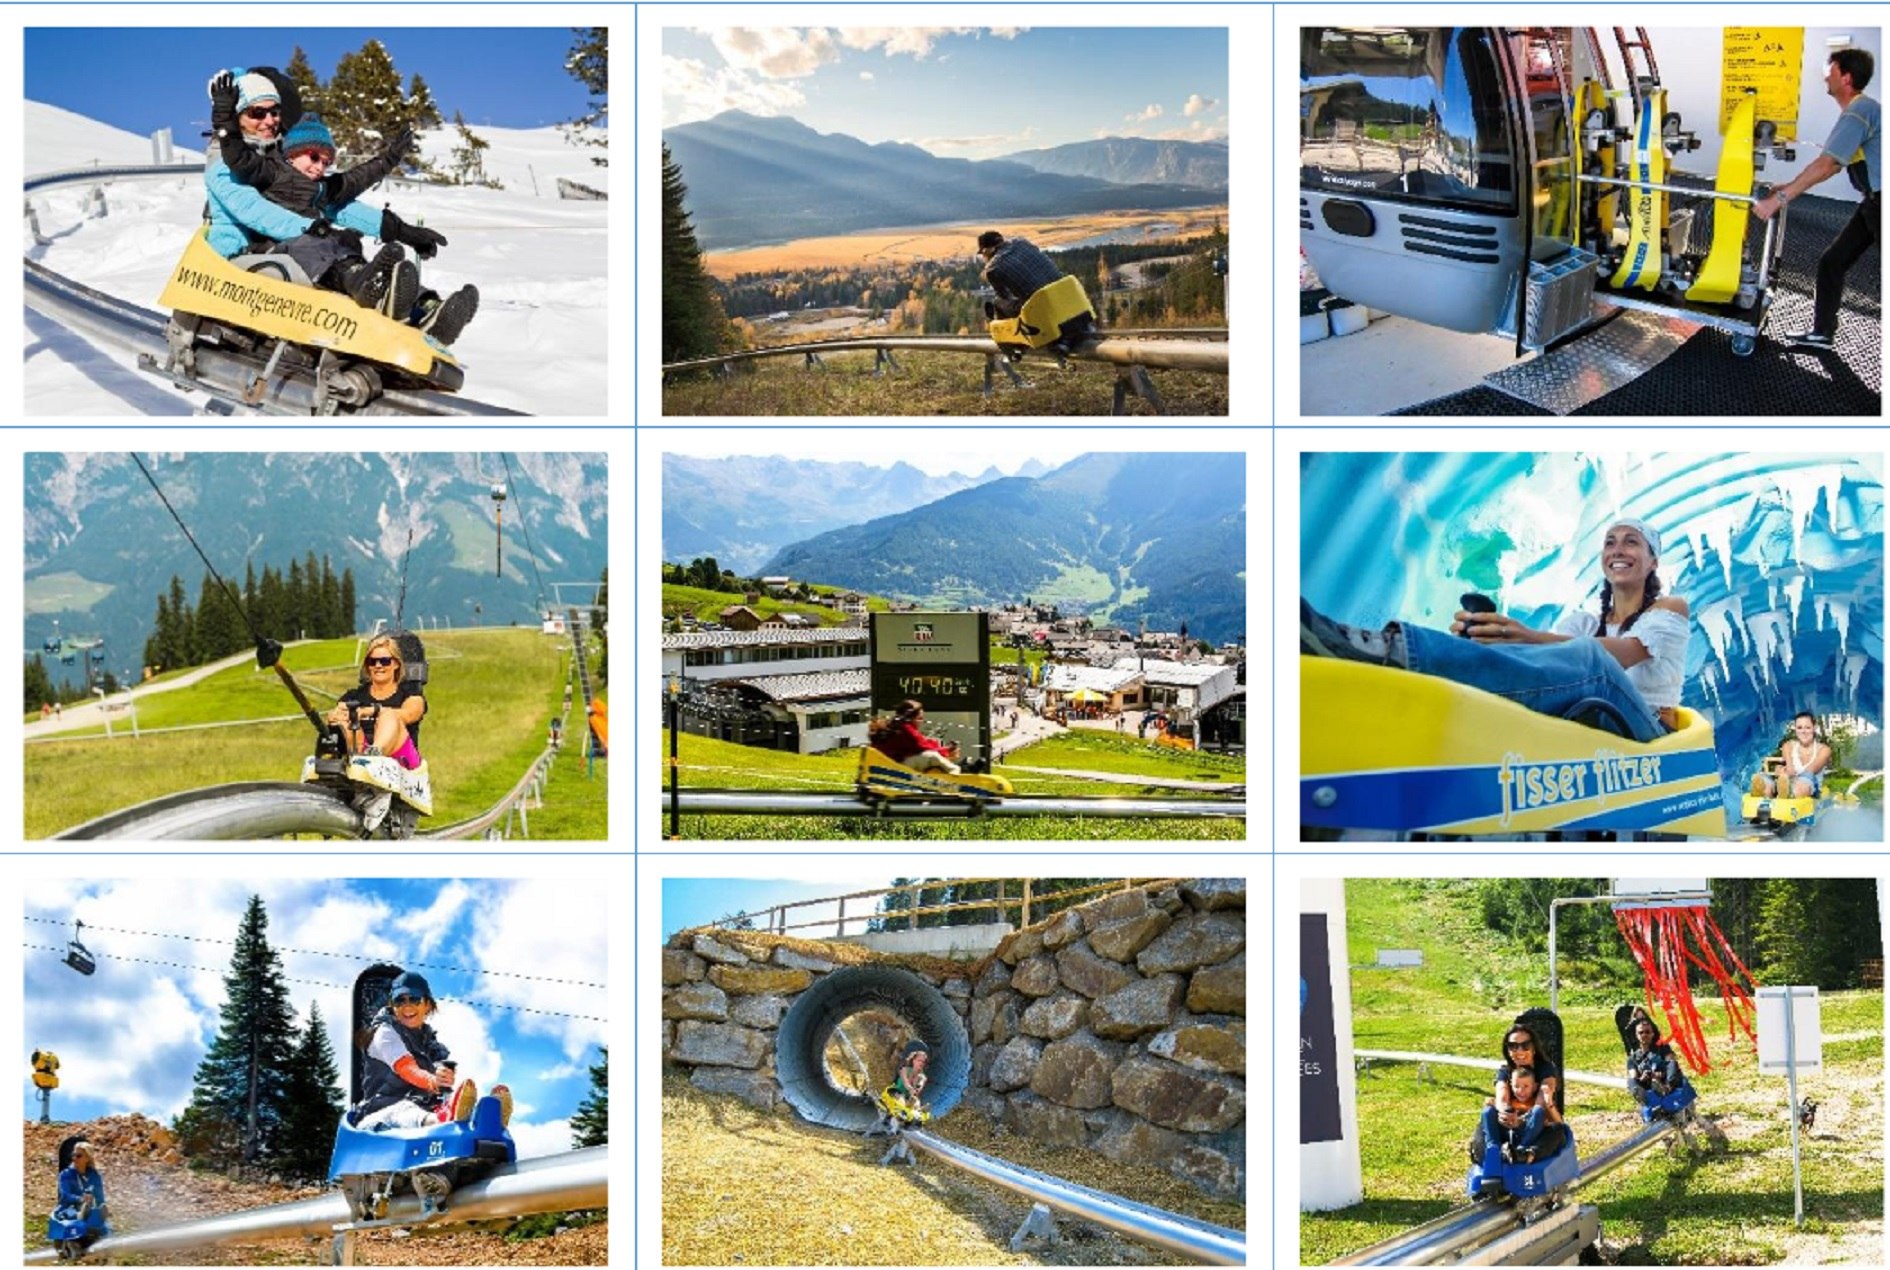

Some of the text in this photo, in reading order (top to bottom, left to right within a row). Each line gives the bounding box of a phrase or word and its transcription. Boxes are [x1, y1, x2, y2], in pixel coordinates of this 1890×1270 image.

[176, 265, 359, 341] www.montgenevre.com
[1497, 748, 1662, 828] fisser flitzer
